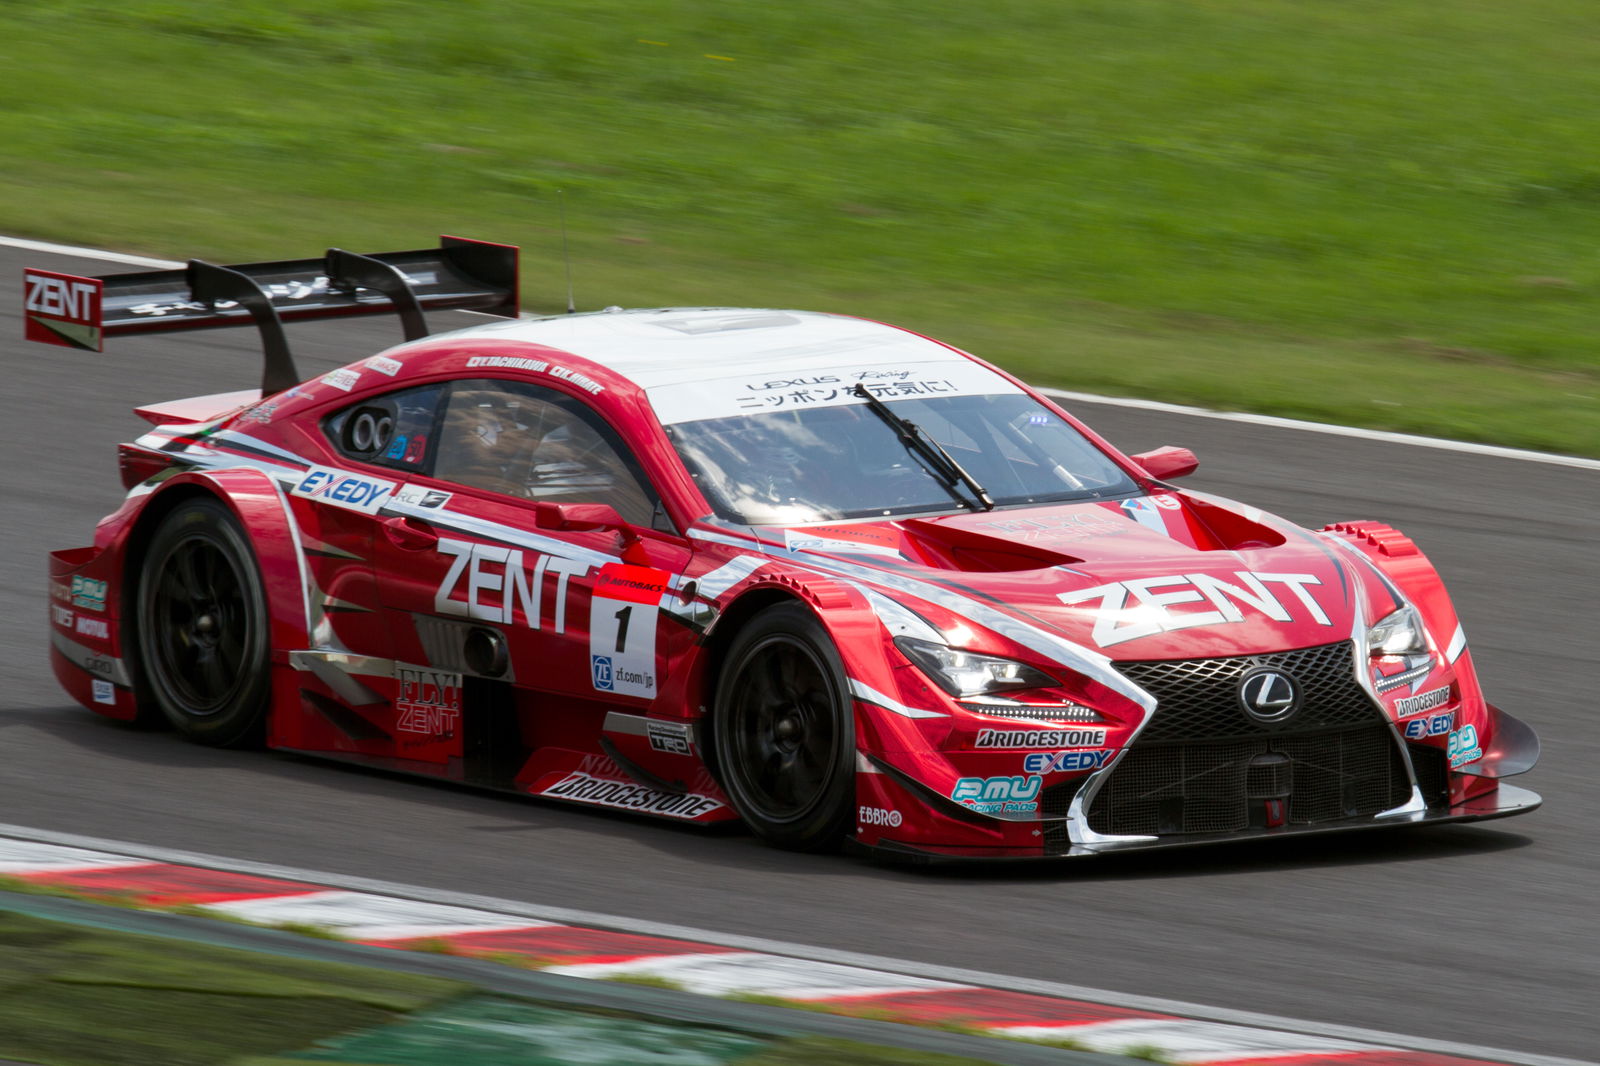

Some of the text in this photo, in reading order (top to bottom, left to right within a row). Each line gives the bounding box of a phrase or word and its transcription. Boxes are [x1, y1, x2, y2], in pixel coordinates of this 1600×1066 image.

[26, 275, 97, 321] ZENT
[746, 370, 917, 391] LEXUS Racing
[299, 471, 391, 507] EXEDY
[434, 537, 592, 635] ZENT
[609, 578, 664, 592] AUTOBACS
[1055, 571, 1333, 649] ZENT
[614, 605, 633, 654] 1
[396, 668, 459, 709] FLY!
[615, 667, 654, 689] zf.com/jp
[1397, 686, 1449, 716] BRIDGESTONE
[396, 701, 459, 737] ZENT
[1406, 712, 1454, 738] EXEDY
[977, 730, 1105, 747] BRIDGESTONE
[1025, 750, 1112, 773] EXEDY
[548, 772, 720, 816] BRIDGESTONE
[1004, 802, 1036, 812] PADS
[859, 806, 902, 828] EBBRO
